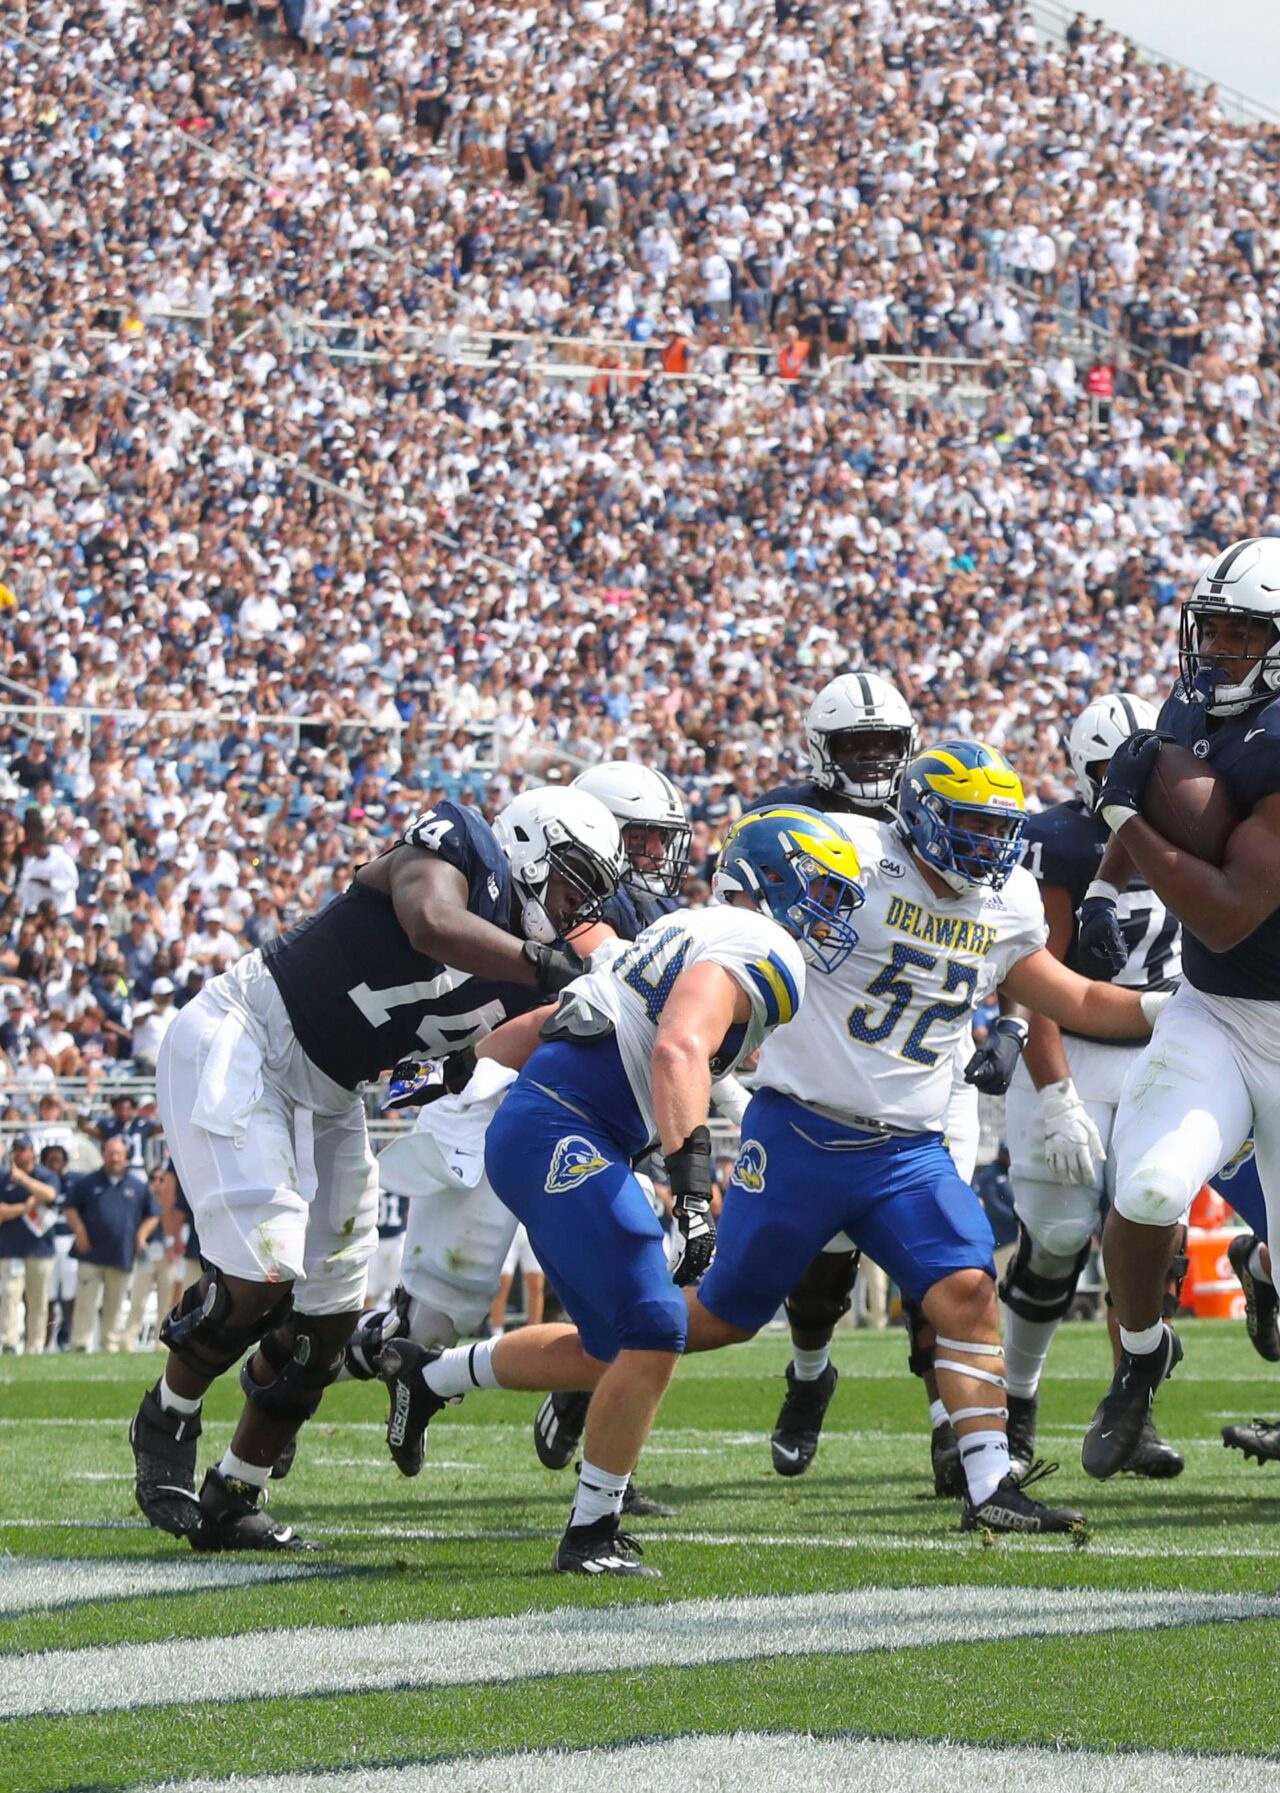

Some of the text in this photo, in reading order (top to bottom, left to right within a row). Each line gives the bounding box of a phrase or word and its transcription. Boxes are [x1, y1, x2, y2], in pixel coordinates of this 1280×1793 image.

[879, 858, 900, 874] CAA
[883, 894, 999, 956] DELAWARE
[847, 940, 979, 1069] 52
[389, 1378, 411, 1447] ADIZERO
